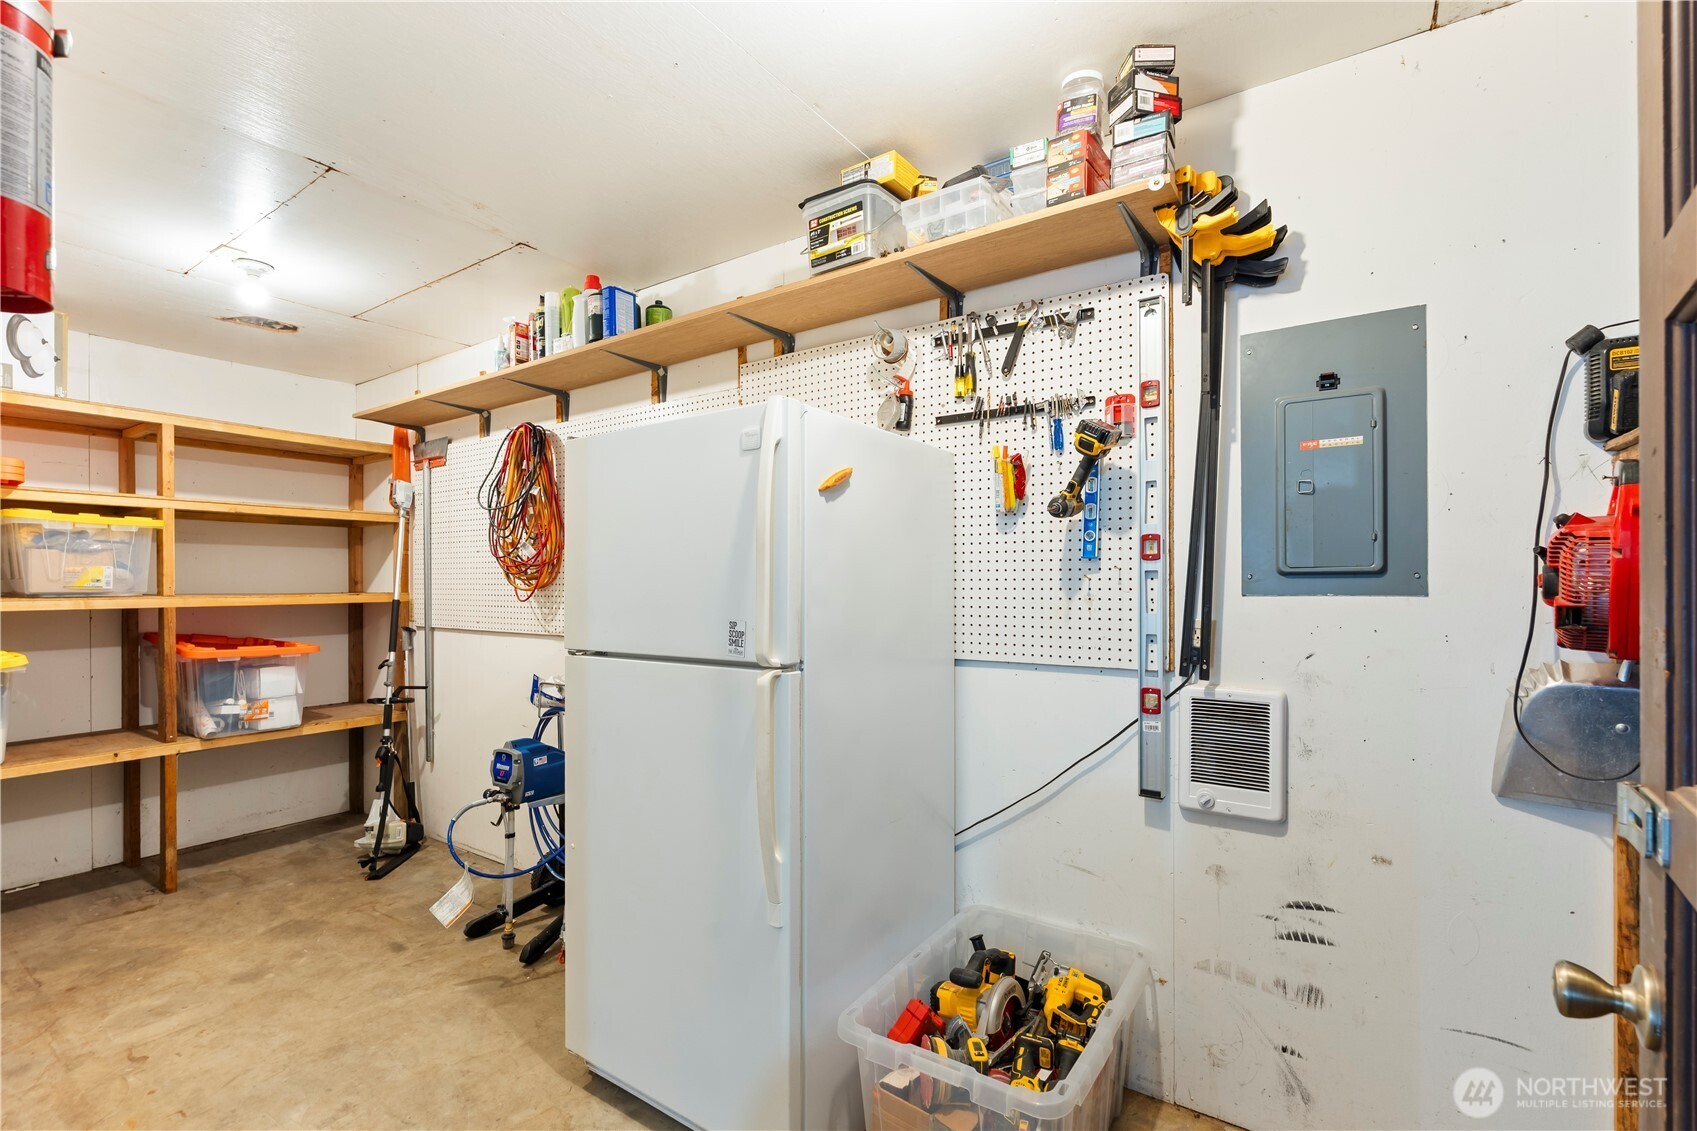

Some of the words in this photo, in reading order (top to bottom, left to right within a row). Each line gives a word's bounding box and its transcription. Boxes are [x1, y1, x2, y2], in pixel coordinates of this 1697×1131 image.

[729, 621, 737, 629] SIP
[729, 630, 744, 639] SCOOP
[728, 638, 744, 647] SMILE
